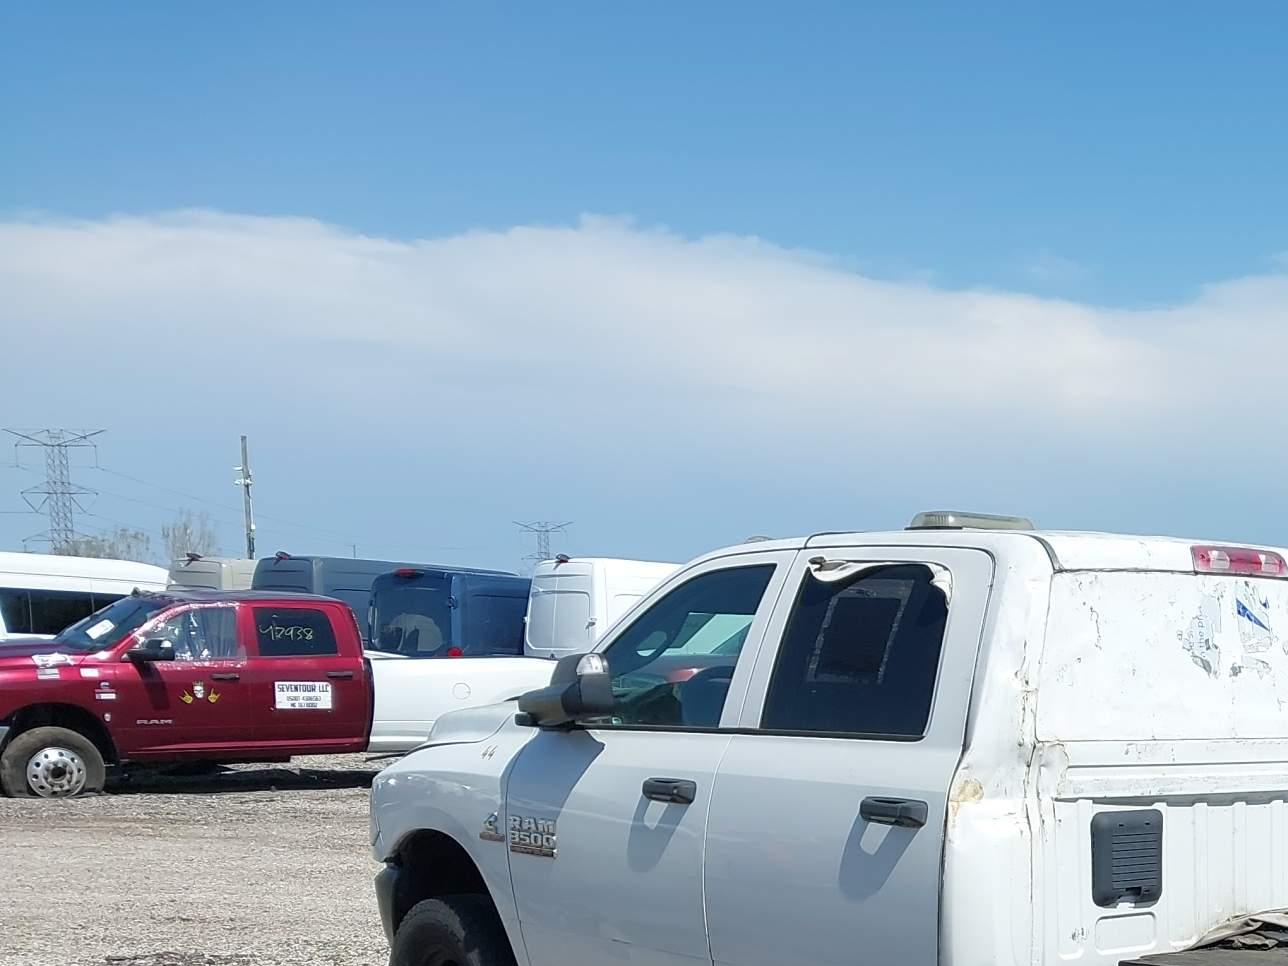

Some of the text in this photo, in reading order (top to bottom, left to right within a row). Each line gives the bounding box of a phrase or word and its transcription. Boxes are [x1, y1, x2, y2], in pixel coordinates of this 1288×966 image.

[277, 683, 330, 693] SEVENTOUR LLC
[508, 815, 557, 833] RAM
